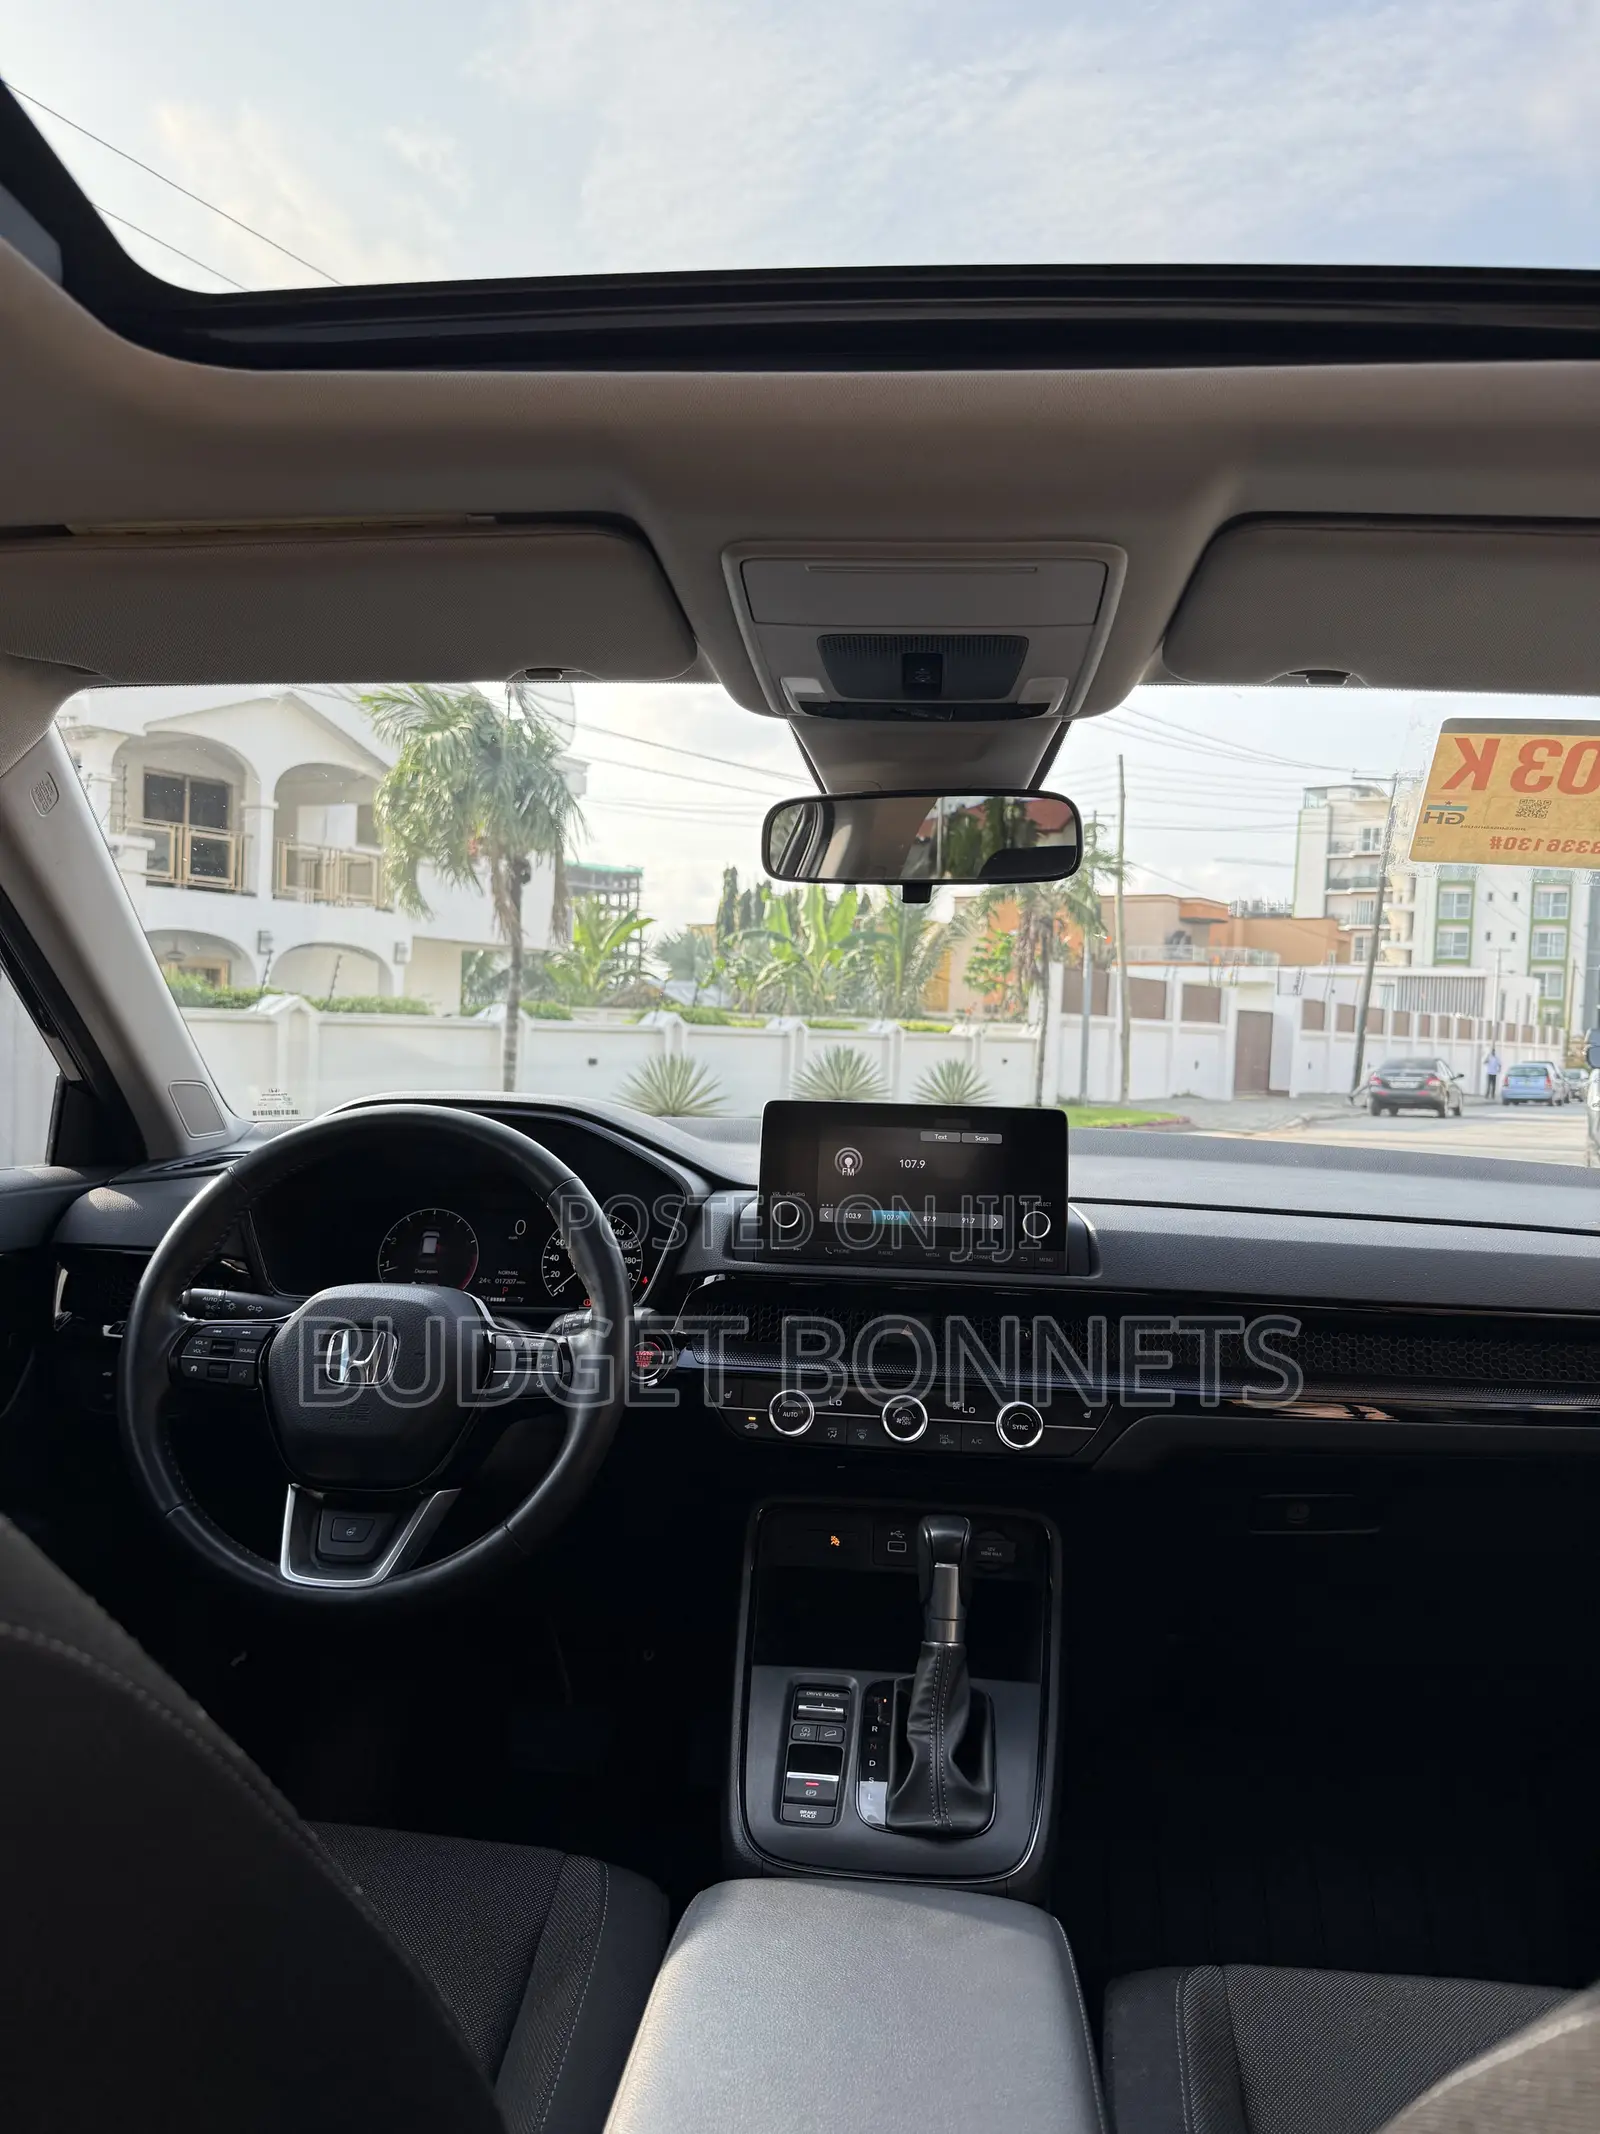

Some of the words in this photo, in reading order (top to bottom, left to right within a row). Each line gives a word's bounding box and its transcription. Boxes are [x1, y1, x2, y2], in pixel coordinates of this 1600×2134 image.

[934, 1133, 948, 1141] Text
[899, 1158, 926, 1169] 107.9
[842, 1167, 855, 1176] FM
[845, 1212, 862, 1220] 103.9
[514, 1219, 527, 1236] 0
[390, 1237, 397, 1245] 2
[549, 1254, 560, 1262] 40
[624, 1256, 637, 1264] 180
[384, 1260, 390, 1268] 1
[550, 1270, 561, 1278] 20
[501, 1286, 509, 1295] P
[828, 1395, 843, 1406] Lo
[962, 1402, 976, 1414] Lo
[1011, 1423, 1029, 1431] SYNC
[871, 1725, 878, 1733] R
[869, 1759, 876, 1767] D
[868, 1776, 875, 1784] S
